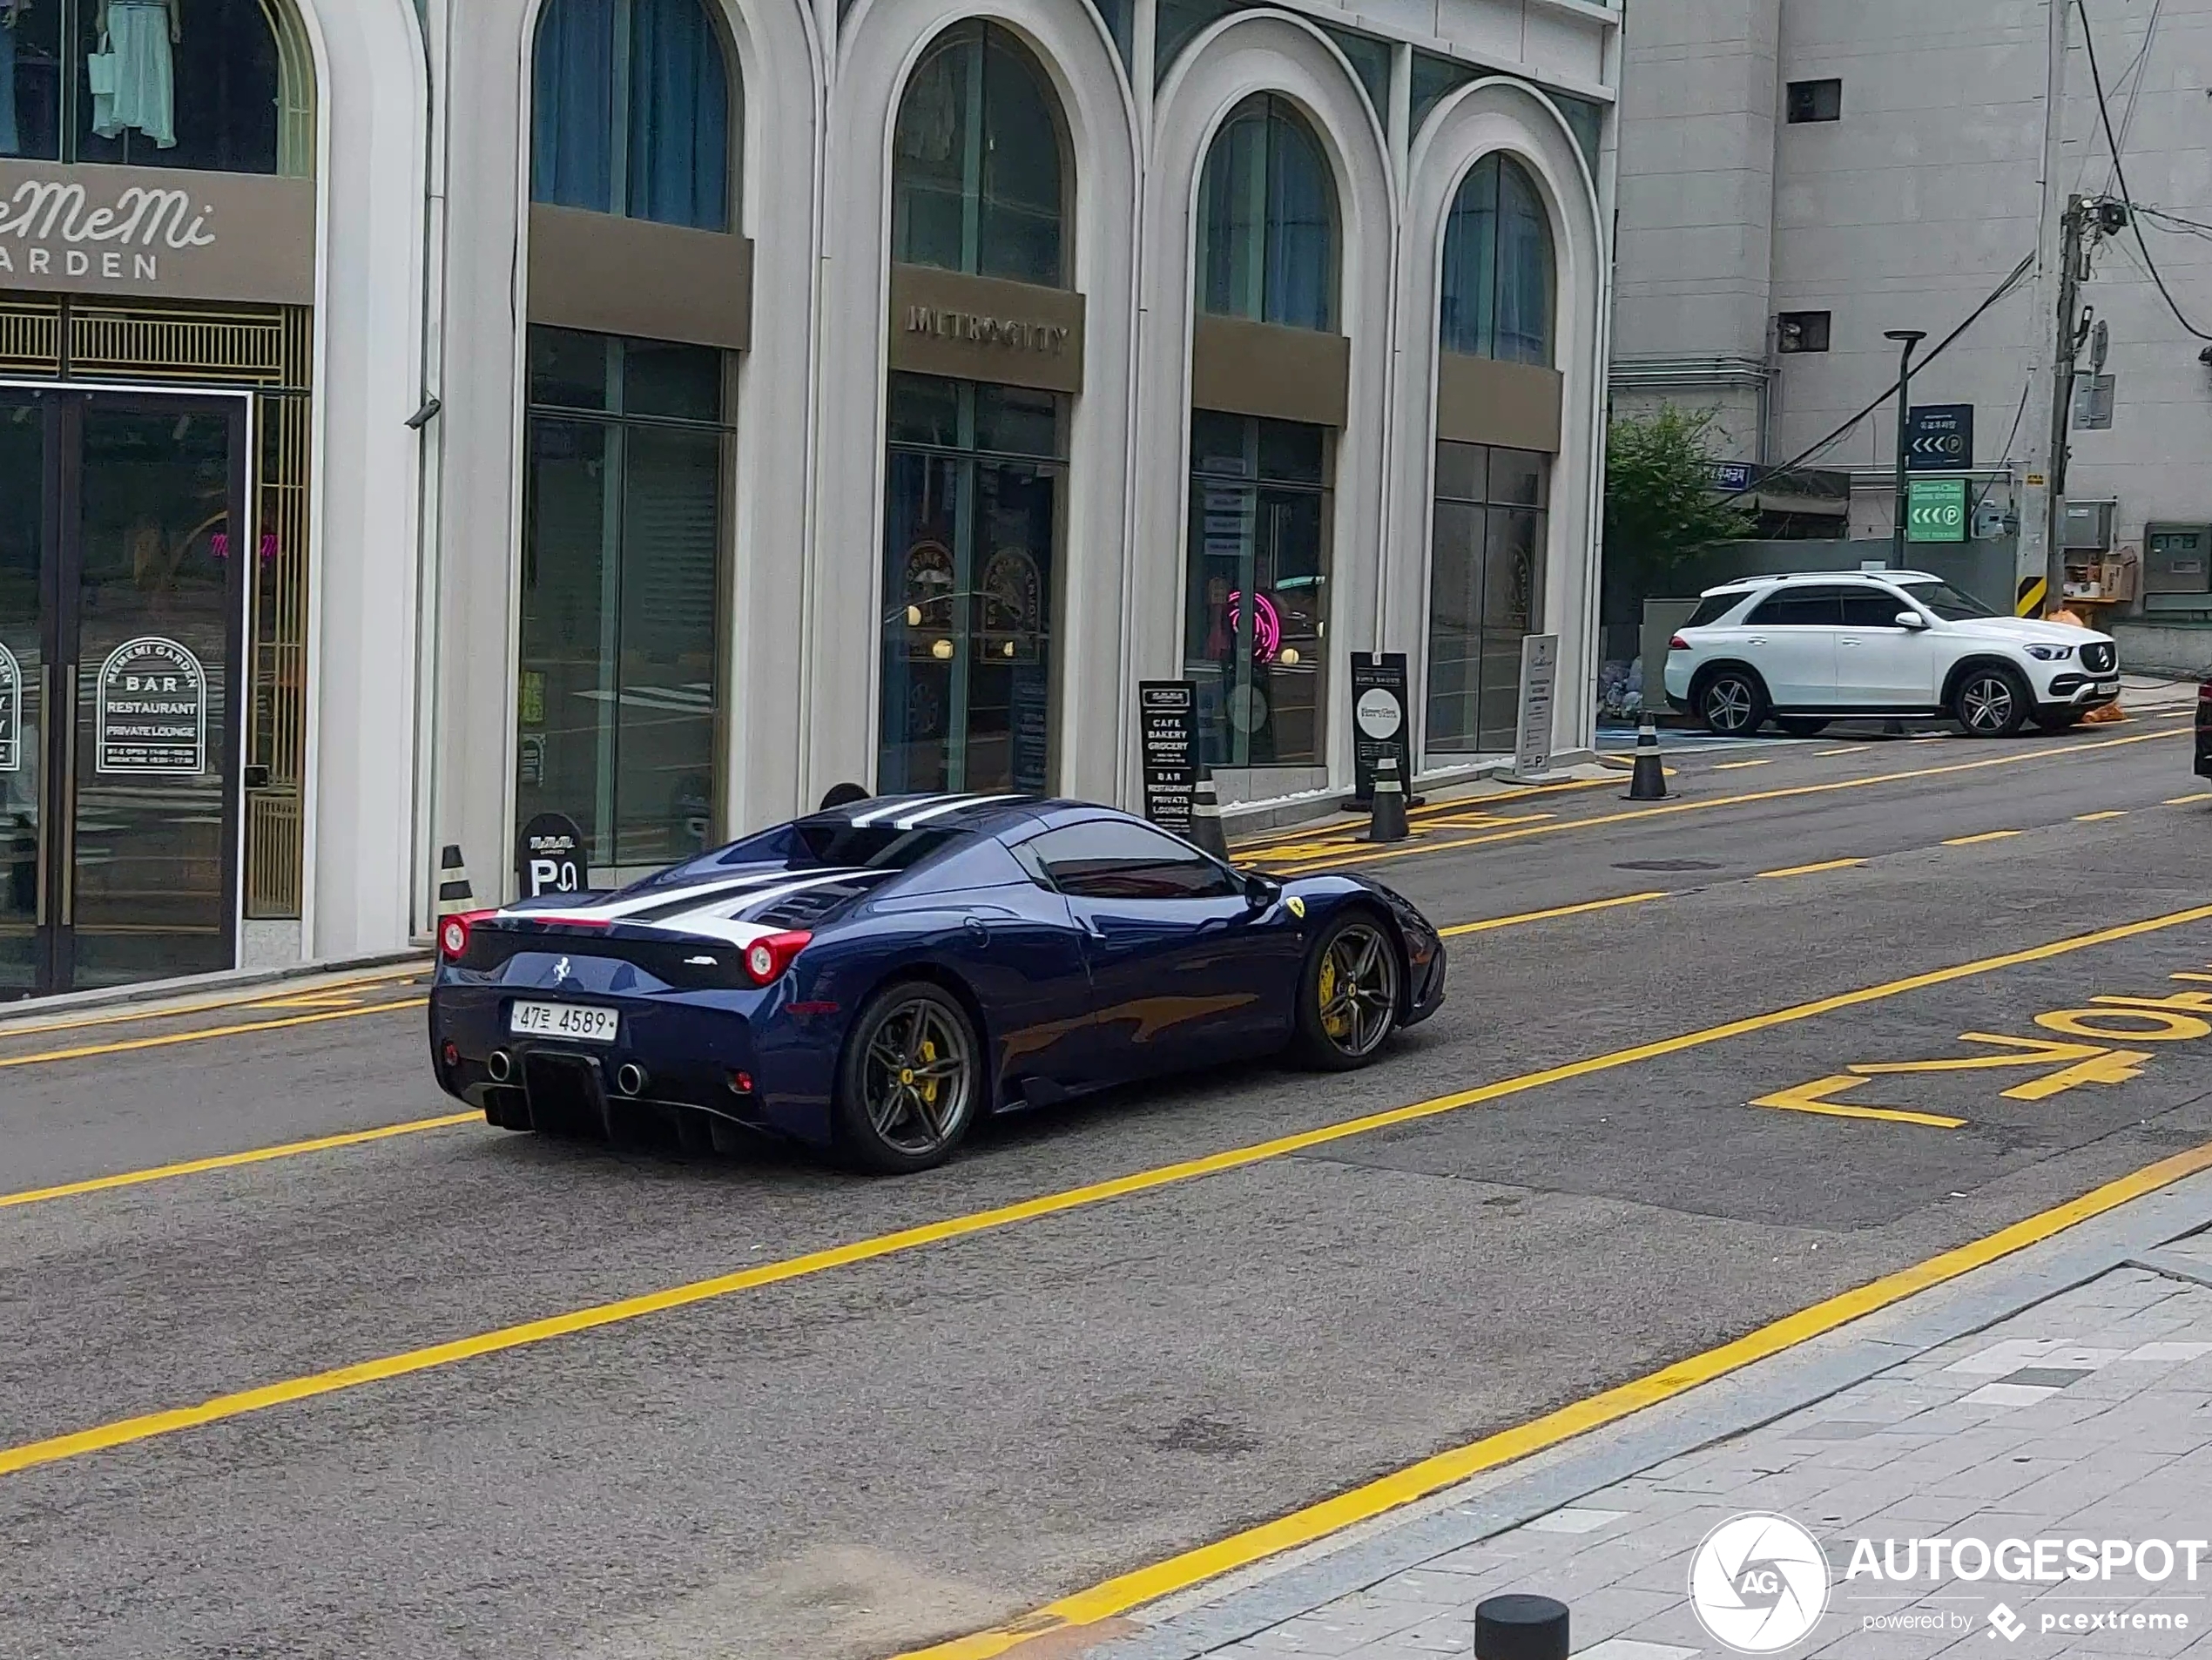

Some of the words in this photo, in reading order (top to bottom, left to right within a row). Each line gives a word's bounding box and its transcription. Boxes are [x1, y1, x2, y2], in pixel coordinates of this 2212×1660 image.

[155, 645, 199, 688] GARDEN
[125, 676, 177, 692] BAR
[106, 701, 197, 714] RESTAURANT
[1152, 719, 1182, 728] CAFE
[105, 725, 152, 736] PRIVATE
[152, 726, 196, 738] LOUNGE
[1148, 730, 1188, 739] BAKERY
[1148, 741, 1189, 751] GROCERY
[1157, 773, 1182, 781] BAR
[529, 860, 559, 897] P
[559, 1009, 606, 1035] 4589
